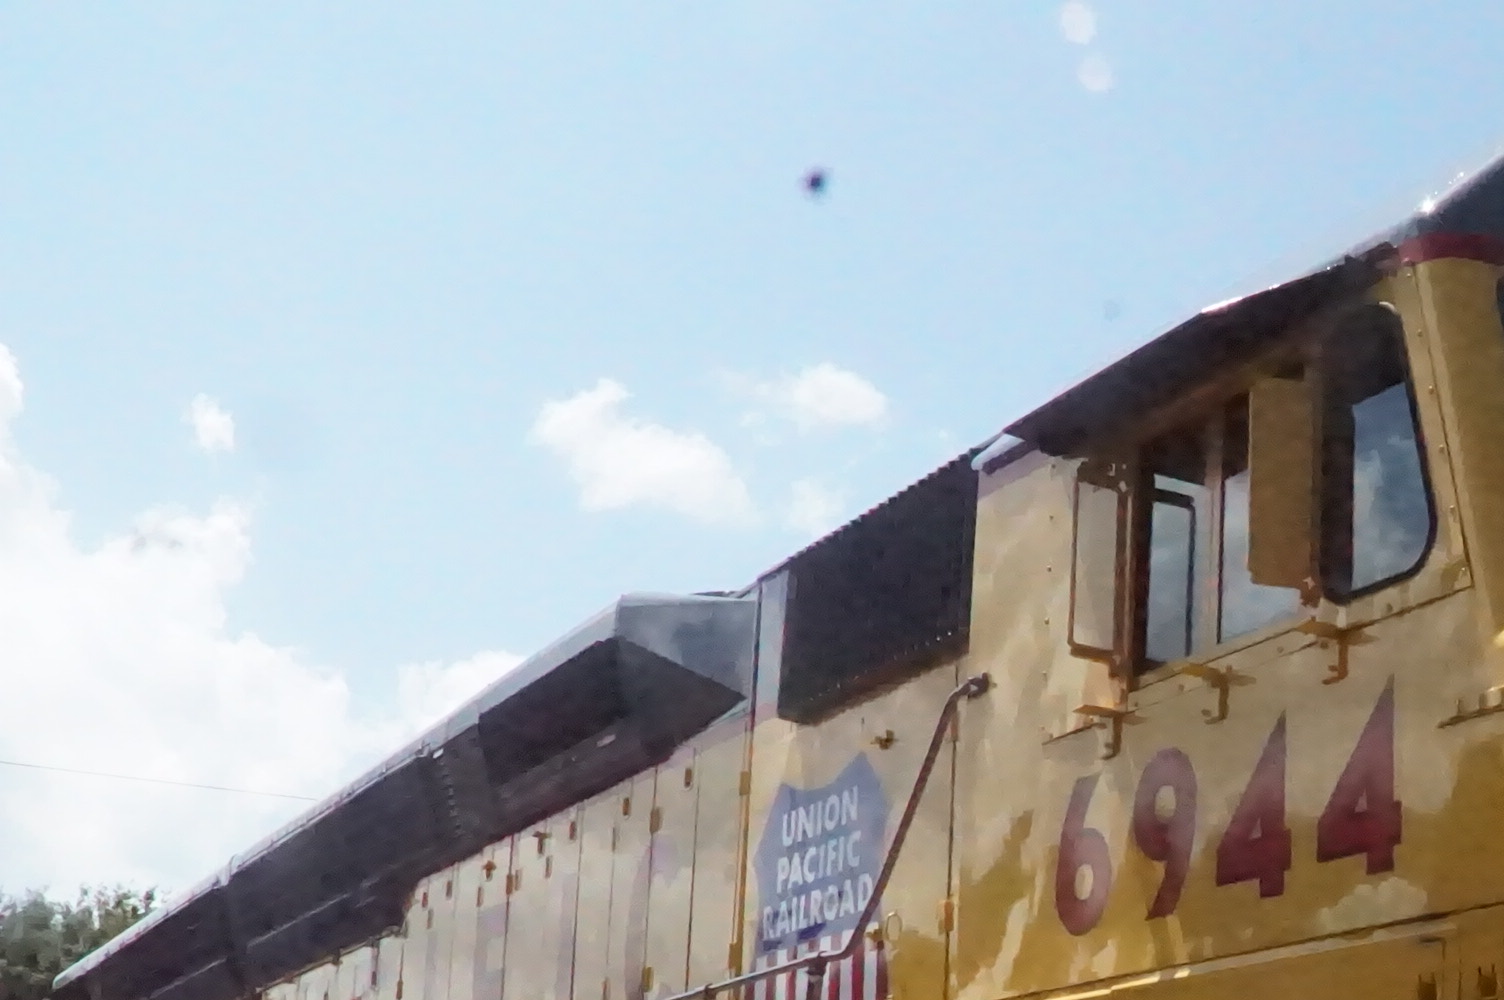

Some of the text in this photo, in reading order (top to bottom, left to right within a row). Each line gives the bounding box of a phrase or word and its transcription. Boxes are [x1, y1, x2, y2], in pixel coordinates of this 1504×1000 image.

[782, 785, 859, 847] UNION
[1055, 673, 1402, 936] 6944
[776, 830, 862, 895] PACIFIC
[763, 872, 873, 939] RAILROAD
